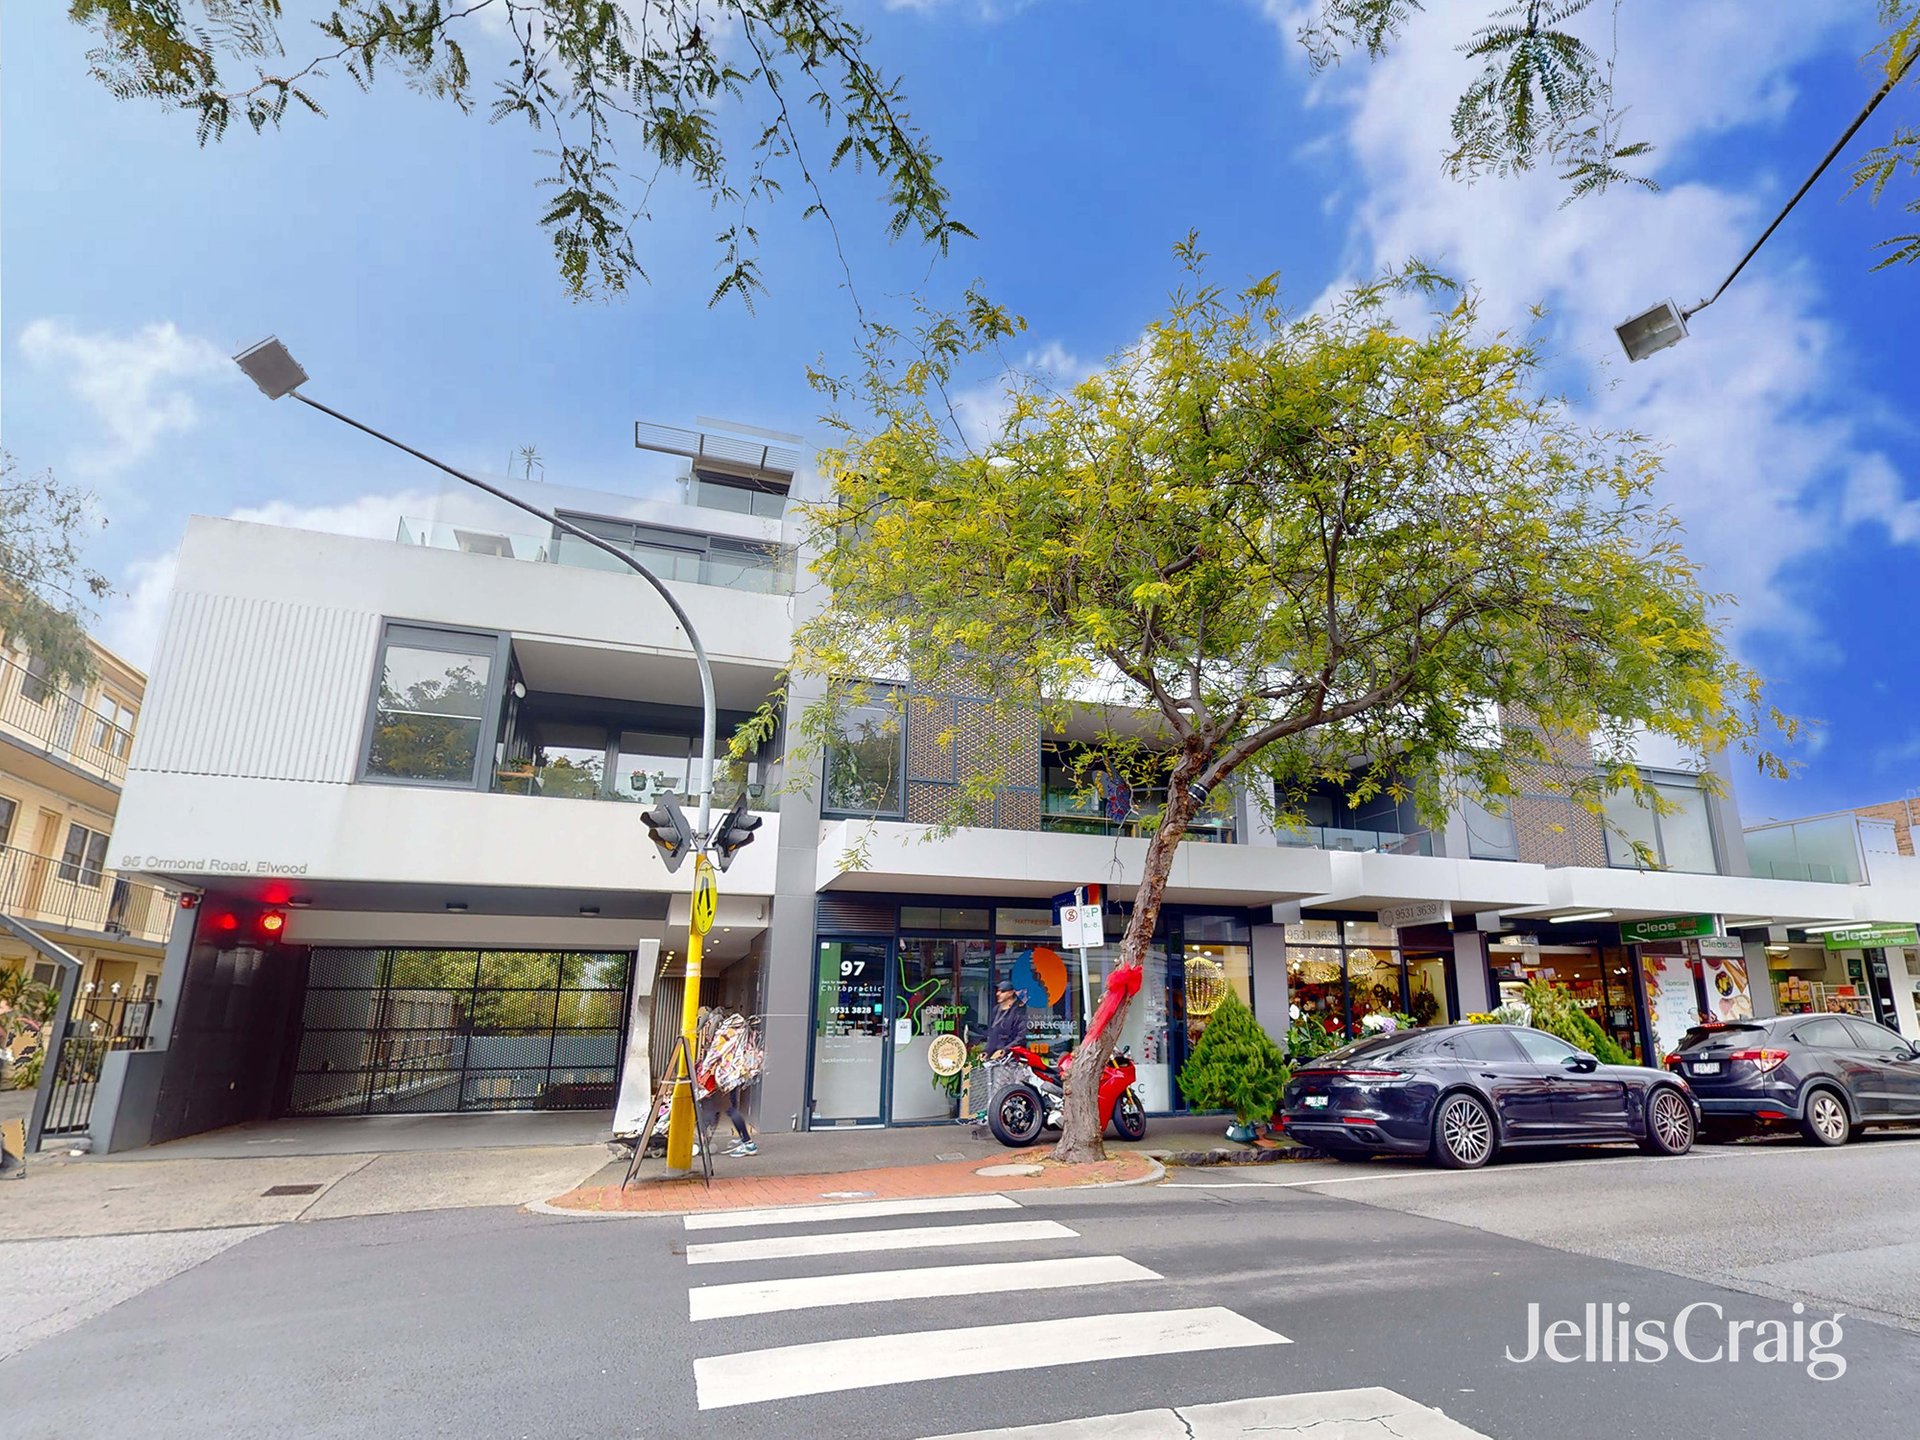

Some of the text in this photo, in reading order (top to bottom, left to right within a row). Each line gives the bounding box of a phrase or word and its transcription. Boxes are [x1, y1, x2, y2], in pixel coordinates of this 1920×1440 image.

[121, 856, 308, 875] 95 Ormond Road, Elwood
[1395, 908, 1415, 920] 9531
[1416, 903, 1437, 917] 3639
[1636, 921, 1677, 934] Cleo's
[1286, 929, 1311, 941] 9531
[840, 960, 866, 976] 97
[829, 1006, 872, 1014] 9531 3828
